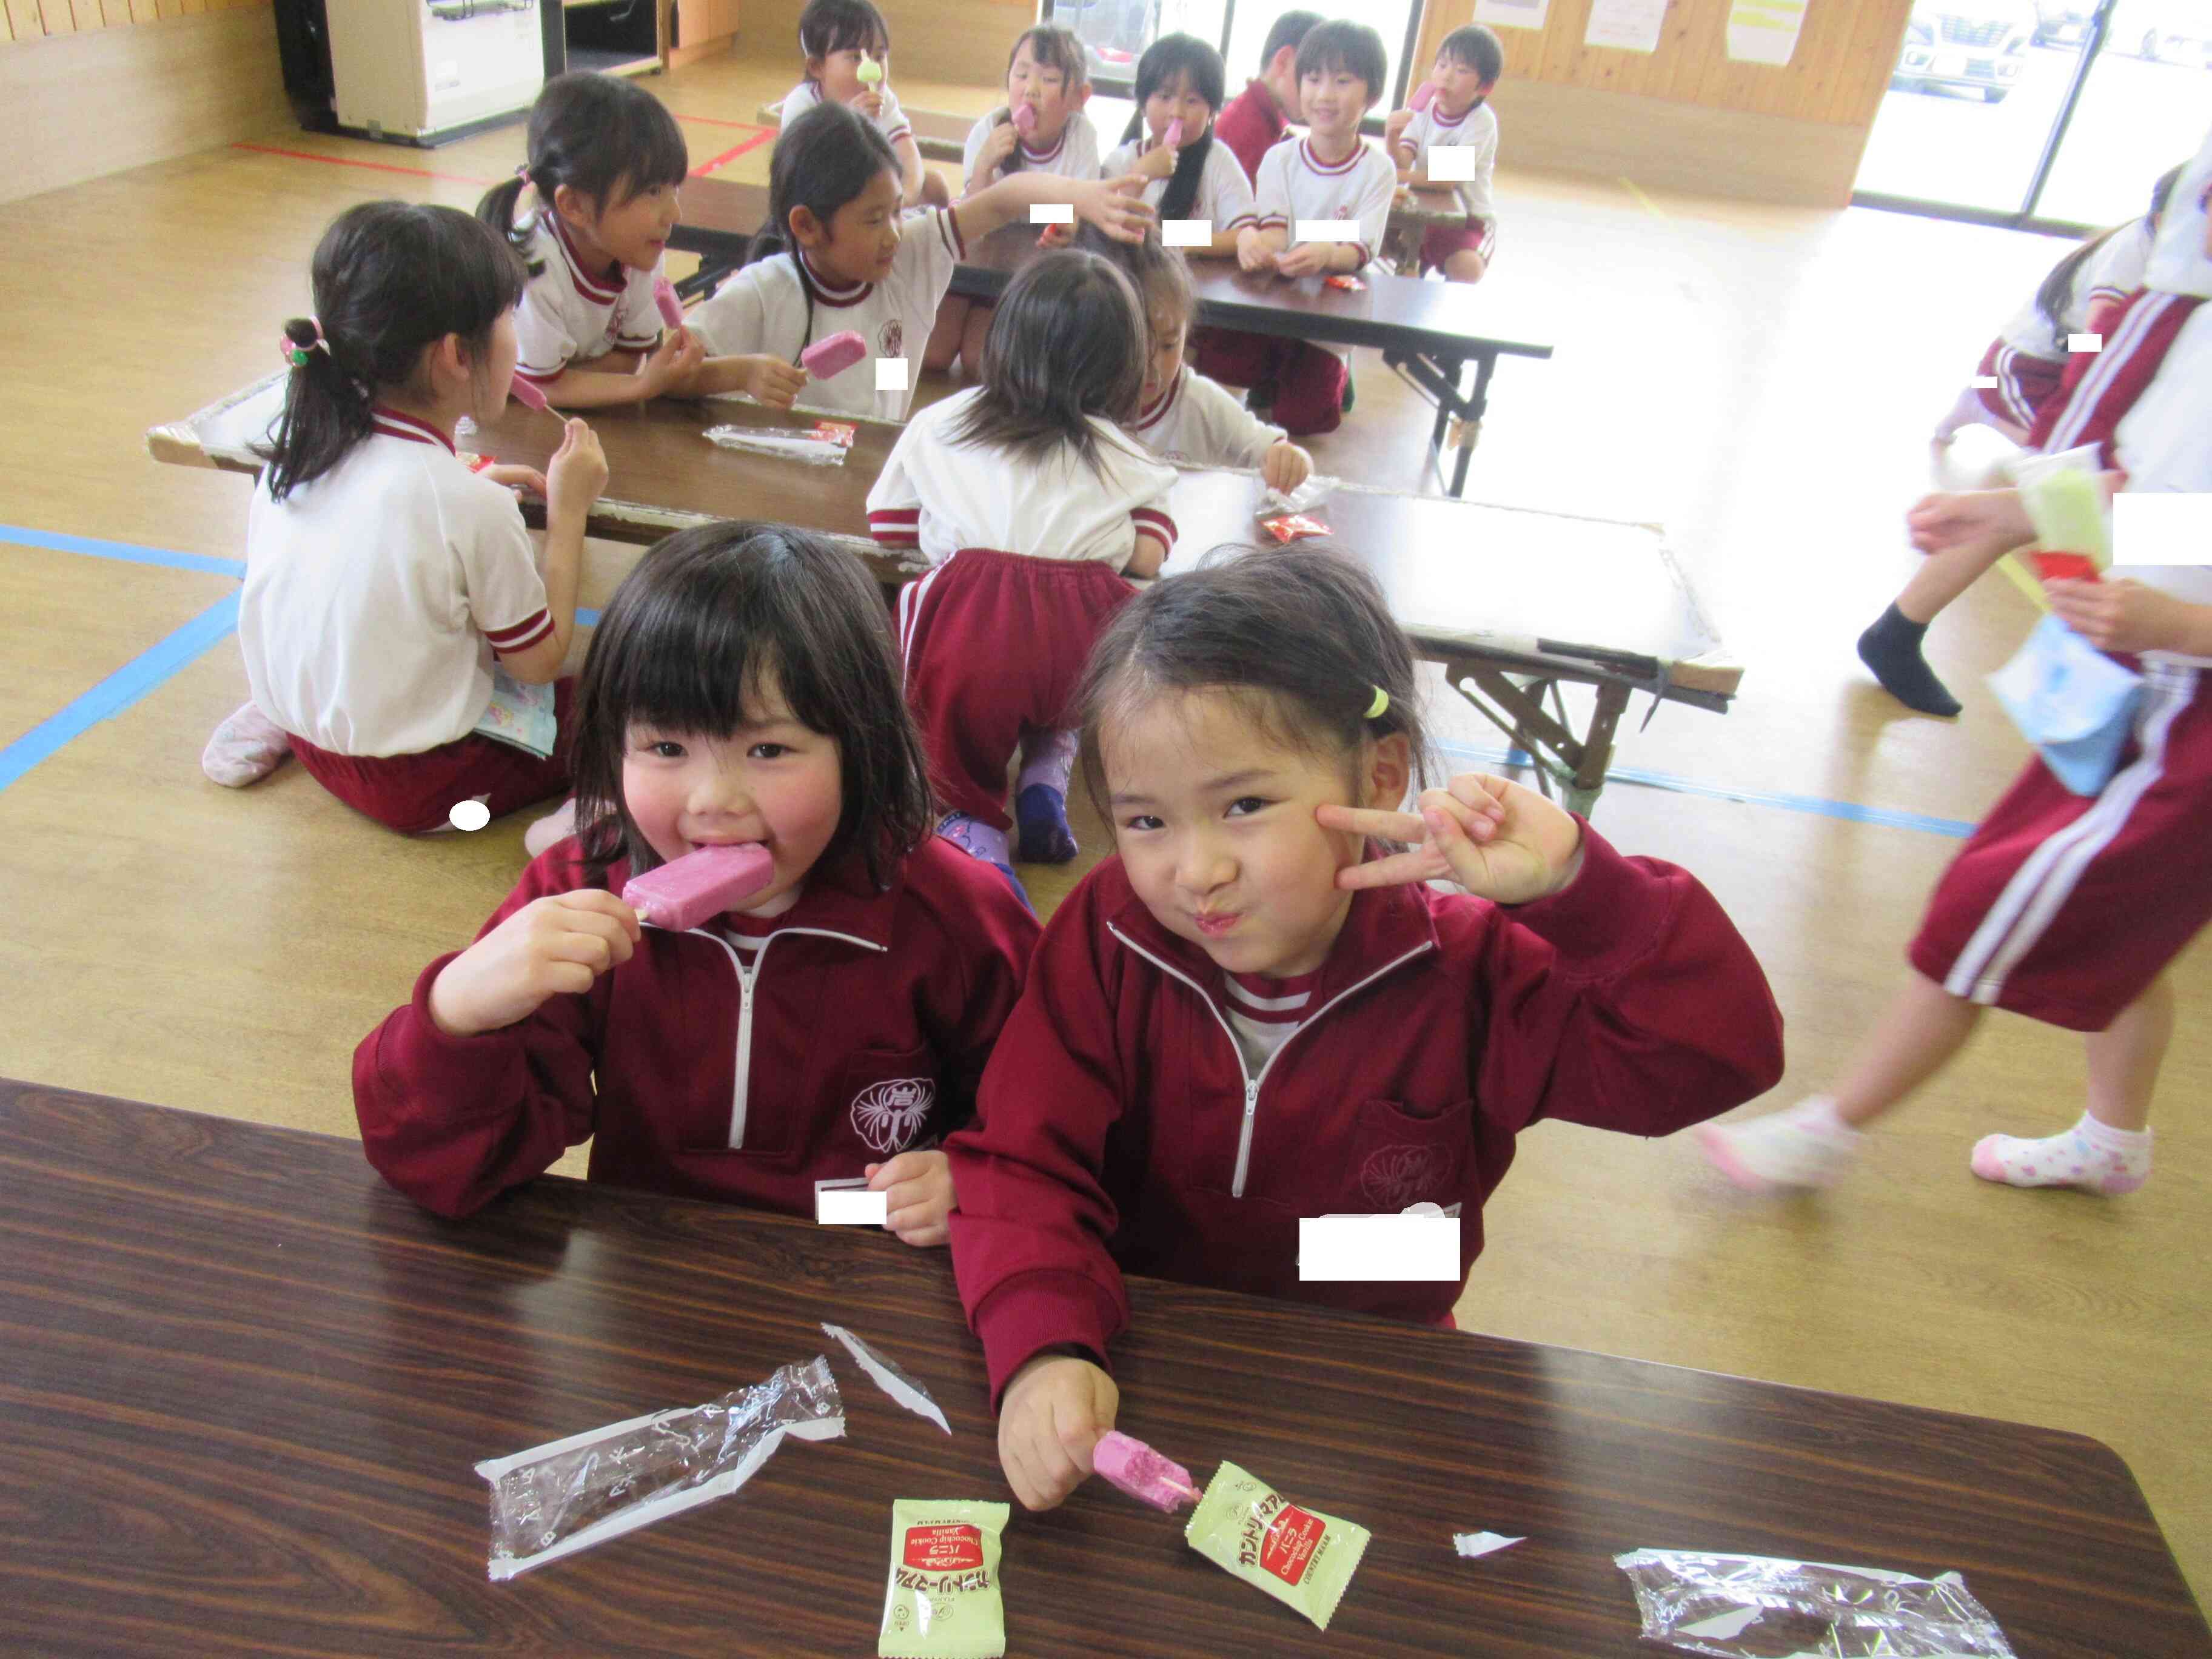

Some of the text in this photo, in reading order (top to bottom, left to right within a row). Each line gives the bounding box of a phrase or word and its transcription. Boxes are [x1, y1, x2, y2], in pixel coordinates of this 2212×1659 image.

[932, 1528, 959, 1537] Vanilla
[1238, 1493, 1286, 1566] カントリーマア
[1280, 1527, 1297, 1553] バニラ
[930, 1545, 960, 1554] バニラ
[939, 1535, 978, 1546] Chocochip
[1281, 1518, 1313, 1575] Chocochip Cookie
[1297, 1539, 1313, 1560] Vanilla
